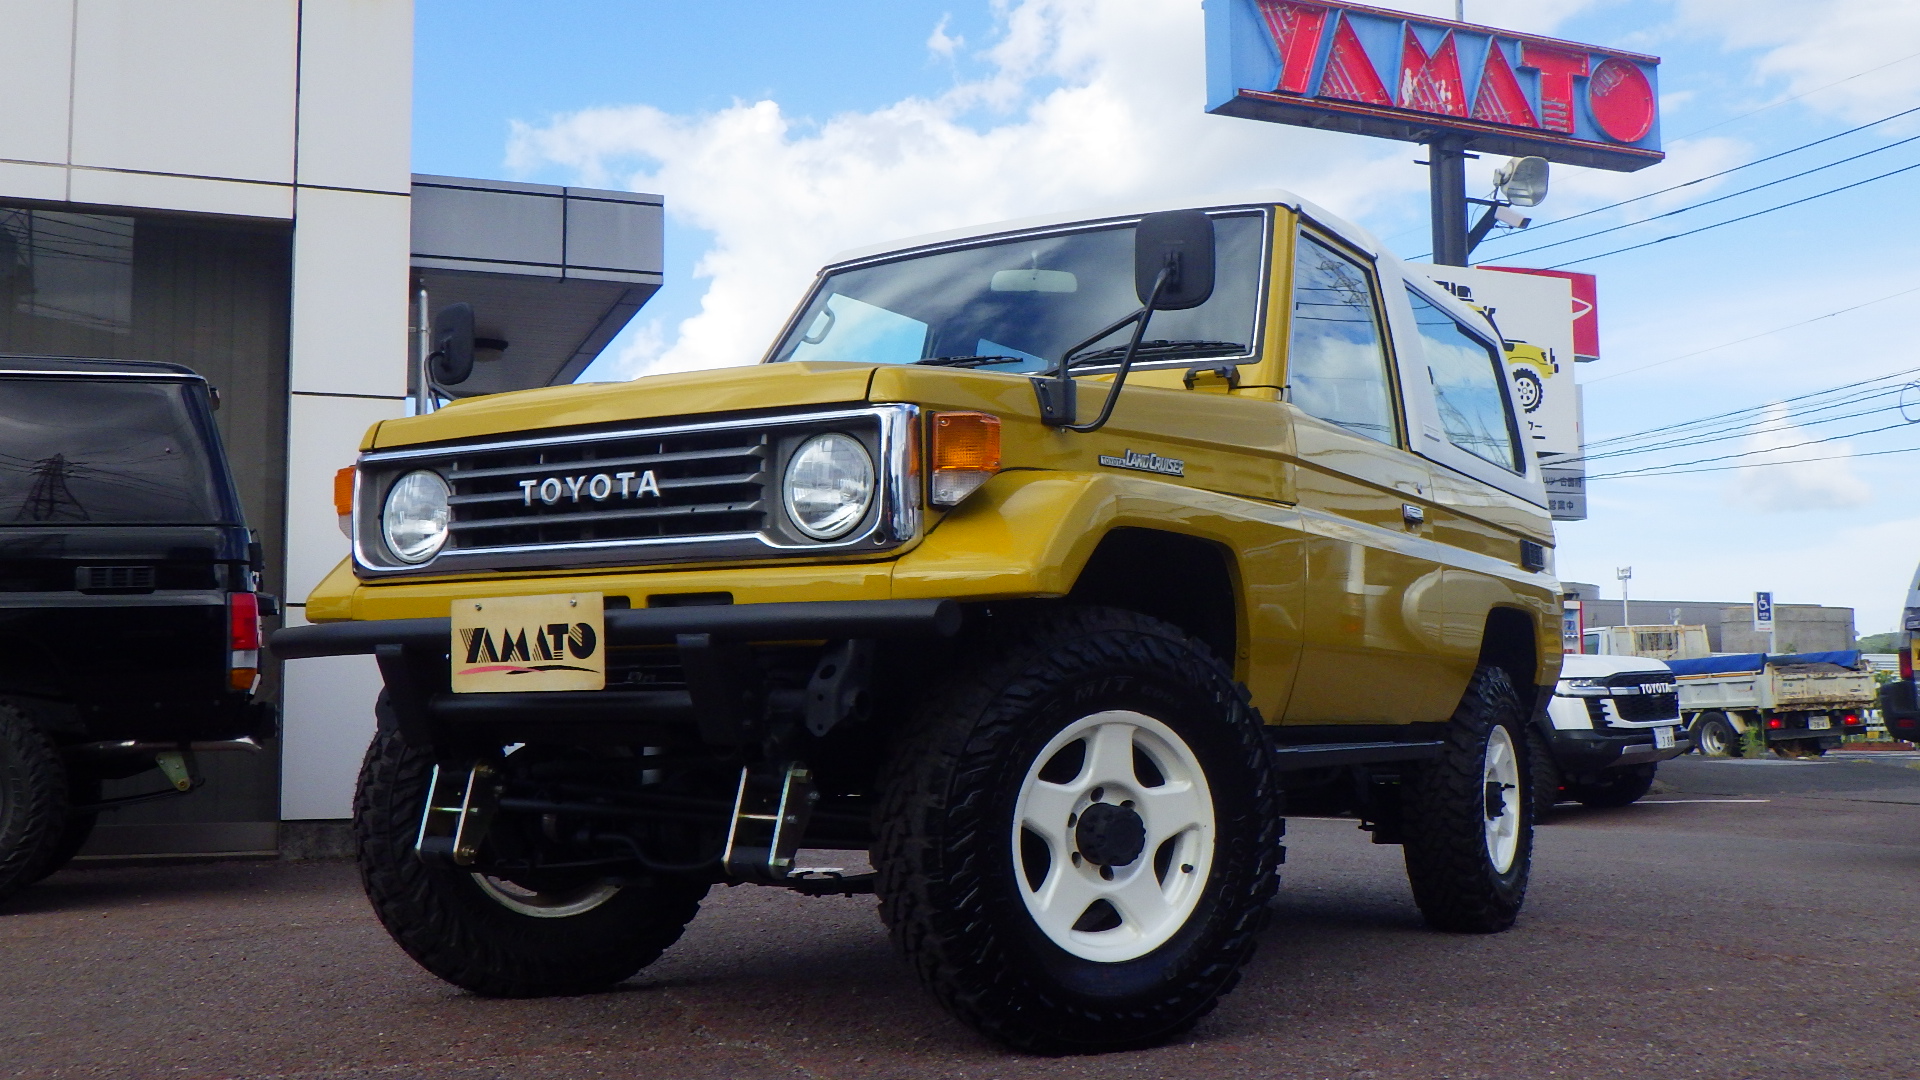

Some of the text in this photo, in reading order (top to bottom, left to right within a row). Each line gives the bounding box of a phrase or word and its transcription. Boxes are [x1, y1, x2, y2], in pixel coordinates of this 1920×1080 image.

[1256, 0, 1655, 143] YAMATO
[519, 470, 661, 507] TOYOTA
[459, 622, 597, 664] YAMATO
[1640, 682, 1673, 695] TOYOTA
